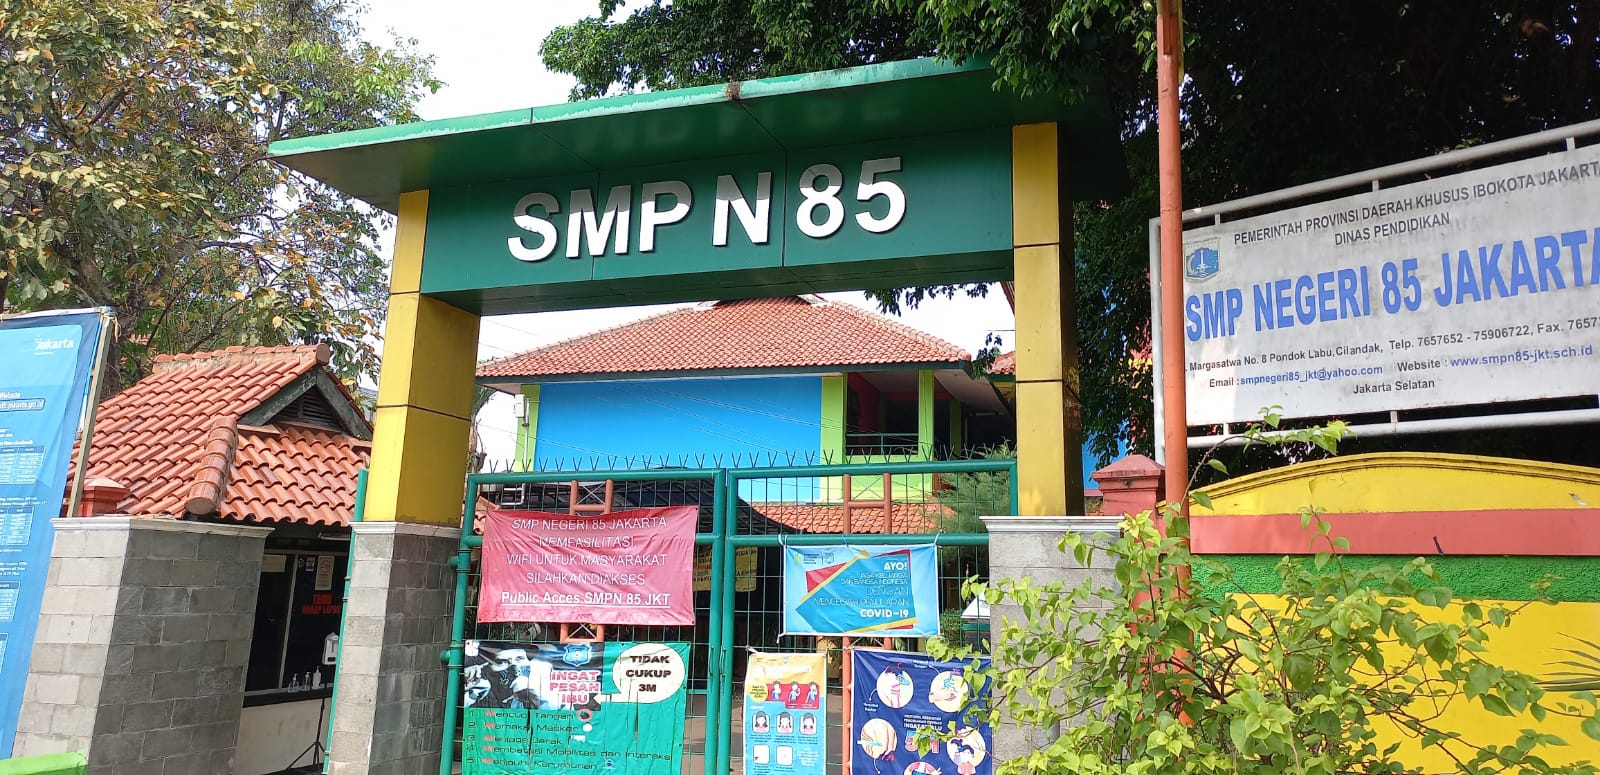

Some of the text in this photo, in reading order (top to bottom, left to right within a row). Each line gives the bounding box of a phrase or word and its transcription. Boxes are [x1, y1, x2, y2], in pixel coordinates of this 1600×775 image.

[507, 157, 906, 262] SMP N 85
[1234, 223, 1302, 245] PEMERINTAH
[1306, 211, 1359, 232] PROVINSI
[1362, 199, 1413, 220] DAERAH
[1415, 187, 1469, 208] KHUSUS
[1473, 174, 1536, 198] IBOKOTA
[1538, 161, 1600, 188] JAKART
[1335, 212, 1450, 246] DINAS PENDIDIKAN
[1185, 227, 1600, 342] SMP NEGERI 85 JAKART
[1189, 358, 1241, 374] Margasatwa
[1244, 355, 1259, 366] No.
[1261, 354, 1267, 364] 8
[1269, 350, 1305, 363] Pondok
[1389, 339, 1414, 352] Telp.
[1418, 333, 1464, 348] 7657652
[1474, 325, 1534, 343] 75906722,
[1537, 323, 1564, 336] Fax.
[1567, 315, 1600, 331] 7657
[1209, 377, 1234, 388] Email
[1396, 358, 1441, 373] Website
[1450, 344, 1593, 369] www.smpn85-jkt.sch.id
[1353, 380, 1435, 396] Jakarta Selatan
[512, 516, 668, 531] SMP NEGERI 85 JAKARTA
[539, 536, 634, 549] MEMFASILITASI
[506, 554, 669, 567] WIFI UNTUK MASYARAKAT
[884, 561, 908, 572] AYO!
[526, 573, 646, 586] SILAHKAN DIAKSES
[866, 586, 909, 597] DENGAN
[501, 592, 671, 607] Public Acces SMPN 85 JKT
[860, 608, 909, 618] COVID-19
[631, 655, 671, 664] TIDAK
[551, 671, 599, 681] INGAT
[625, 669, 672, 678] CUKUP
[549, 682, 600, 692] PESAN
[638, 684, 657, 692] 3M
[561, 694, 588, 703] IBU
[536, 724, 579, 732] Masker
[600, 750, 621, 758] dan
